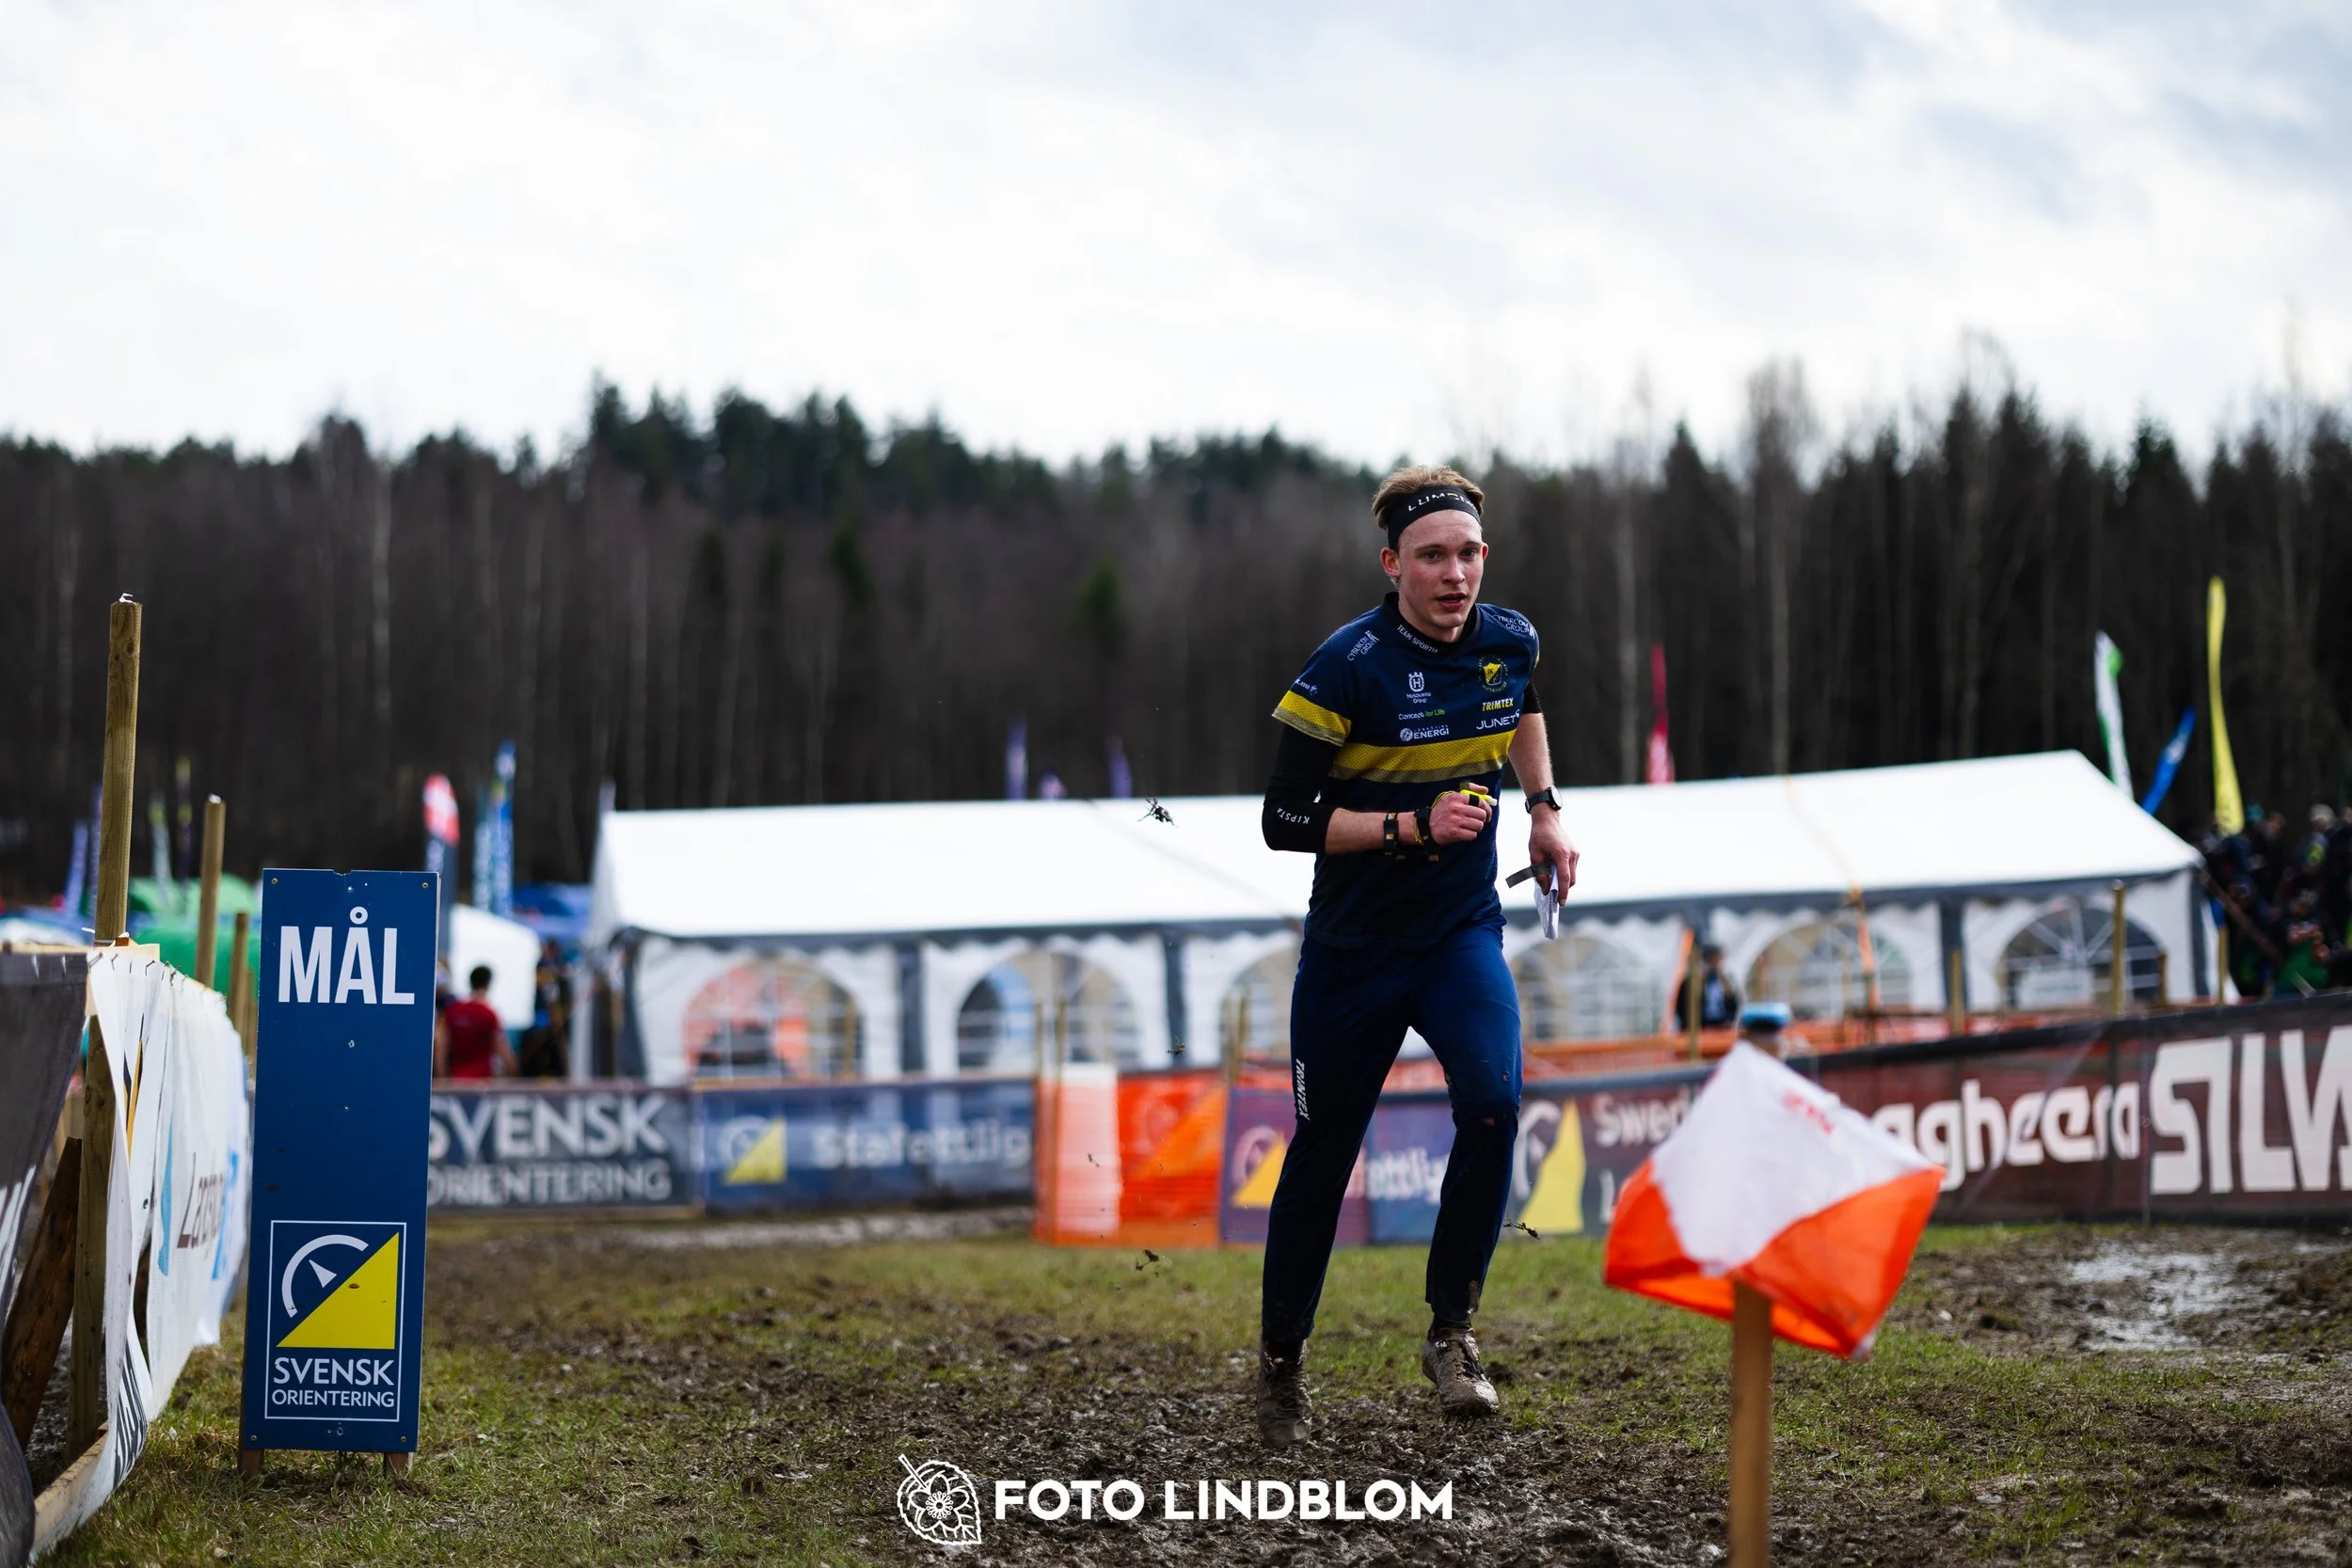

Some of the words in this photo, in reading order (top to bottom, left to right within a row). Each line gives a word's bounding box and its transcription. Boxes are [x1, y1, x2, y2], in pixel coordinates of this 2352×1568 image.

[1396, 624, 1413, 641] TEAM
[1398, 712, 1424, 721] Concept
[1482, 697, 1514, 711] TRIMTEX
[1413, 727, 1450, 739] ENERGI
[1476, 714, 1517, 730] JUNET
[1277, 807, 1311, 825] KIPSTA
[278, 906, 415, 1005] MÅL
[1295, 1058, 1311, 1121] TRIMTEX
[1592, 1084, 1692, 1148] Swed
[2151, 1022, 2352, 1195] SILV
[809, 1120, 1031, 1169] Stafettlig
[1872, 1079, 2140, 1192] agheera
[273, 1356, 395, 1386] SVENSK
[271, 1388, 395, 1408] ORIENTERING
